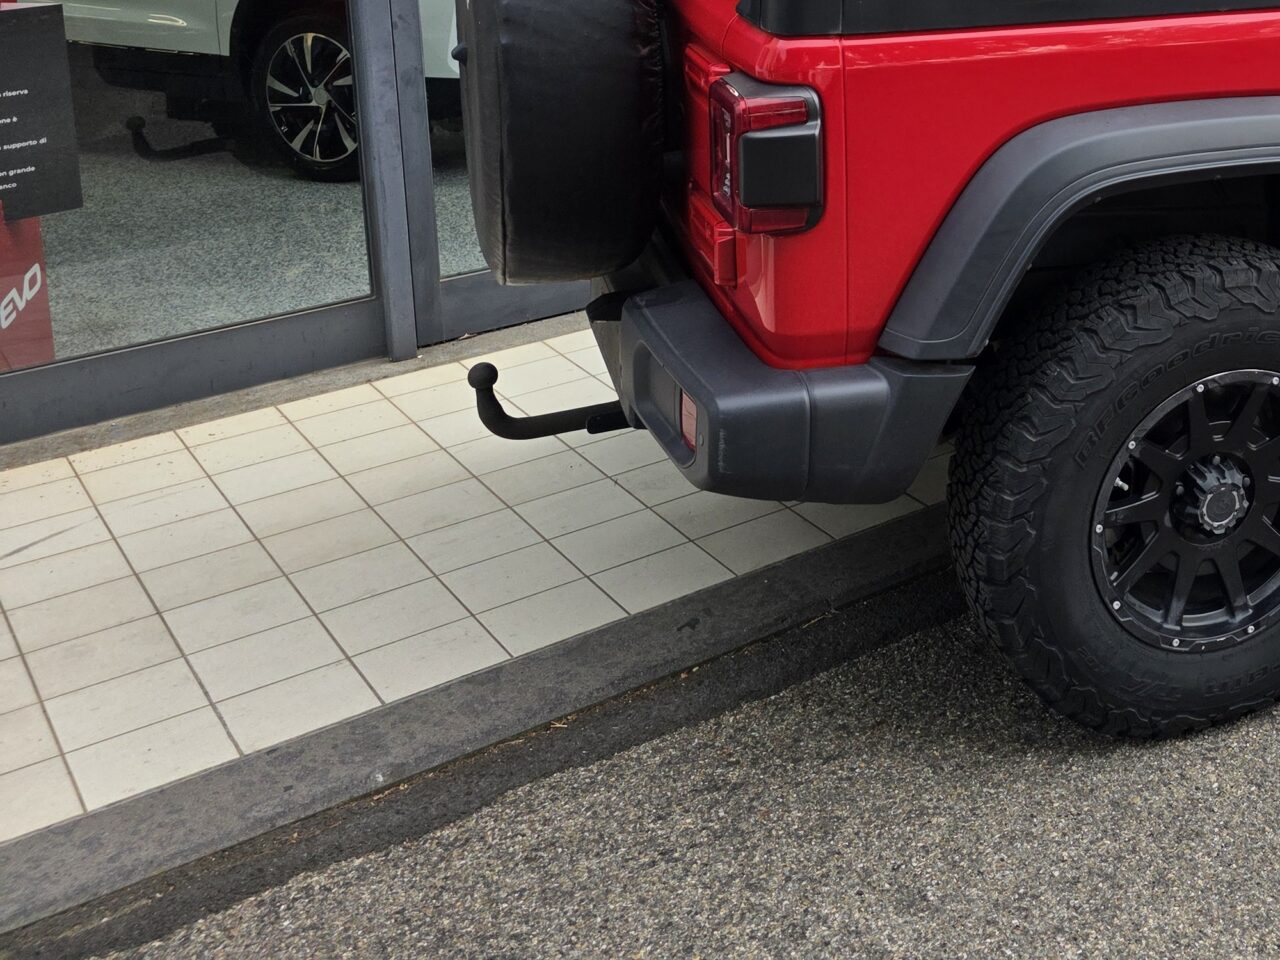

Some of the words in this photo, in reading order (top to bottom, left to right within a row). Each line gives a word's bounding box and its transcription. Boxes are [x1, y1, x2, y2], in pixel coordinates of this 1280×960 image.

[2, 88, 29, 98] riserva
[3, 139, 38, 150] supporto
[39, 137, 48, 145] di
[8, 165, 36, 177] grande
[0, 262, 42, 329] EVO
